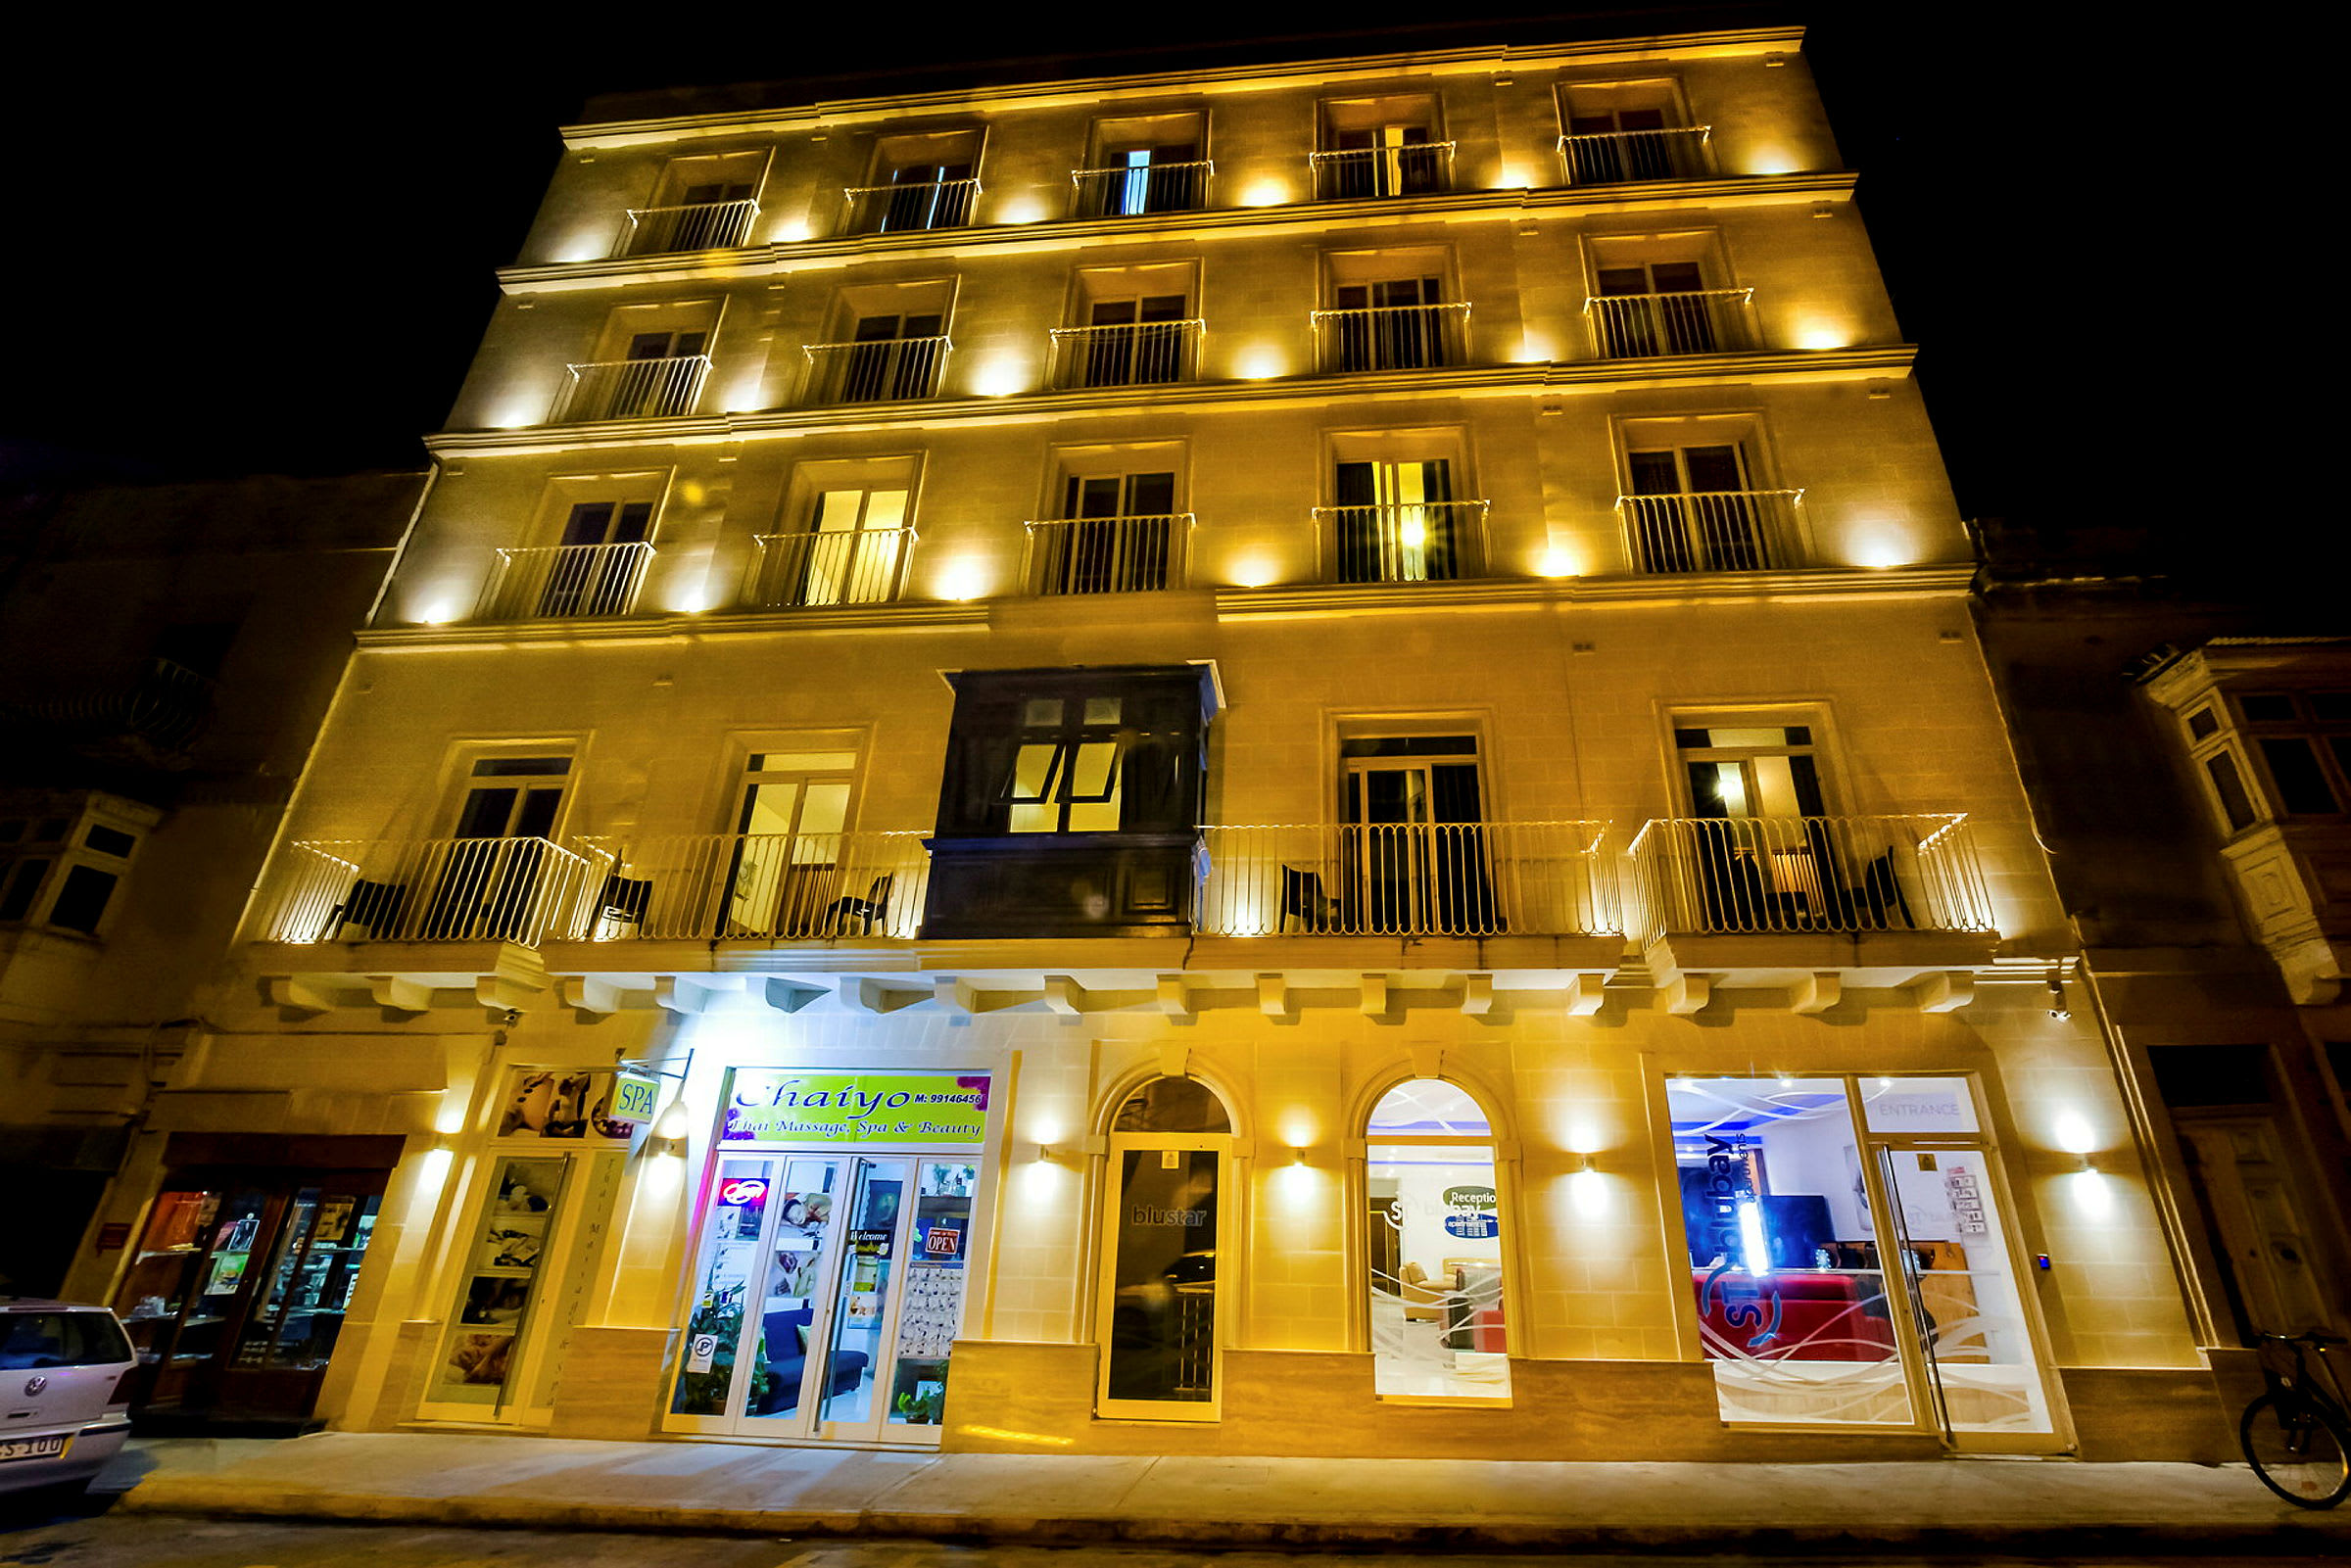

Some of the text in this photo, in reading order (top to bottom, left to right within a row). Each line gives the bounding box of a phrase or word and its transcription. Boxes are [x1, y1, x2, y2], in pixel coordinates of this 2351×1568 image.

[619, 1083, 652, 1115] SPA
[736, 1079, 911, 1119] Chaiyo
[914, 1093, 983, 1104] M: 99146456
[1880, 1103, 1960, 1117] ENTRANCE
[856, 1120, 888, 1139] Spa
[893, 1120, 914, 1133] &
[918, 1120, 982, 1140] Beauty
[1451, 1191, 1497, 1207] Receptio
[1131, 1205, 1207, 1227] blustar
[850, 1230, 888, 1242] Welcome
[928, 1235, 956, 1252] OPEN
